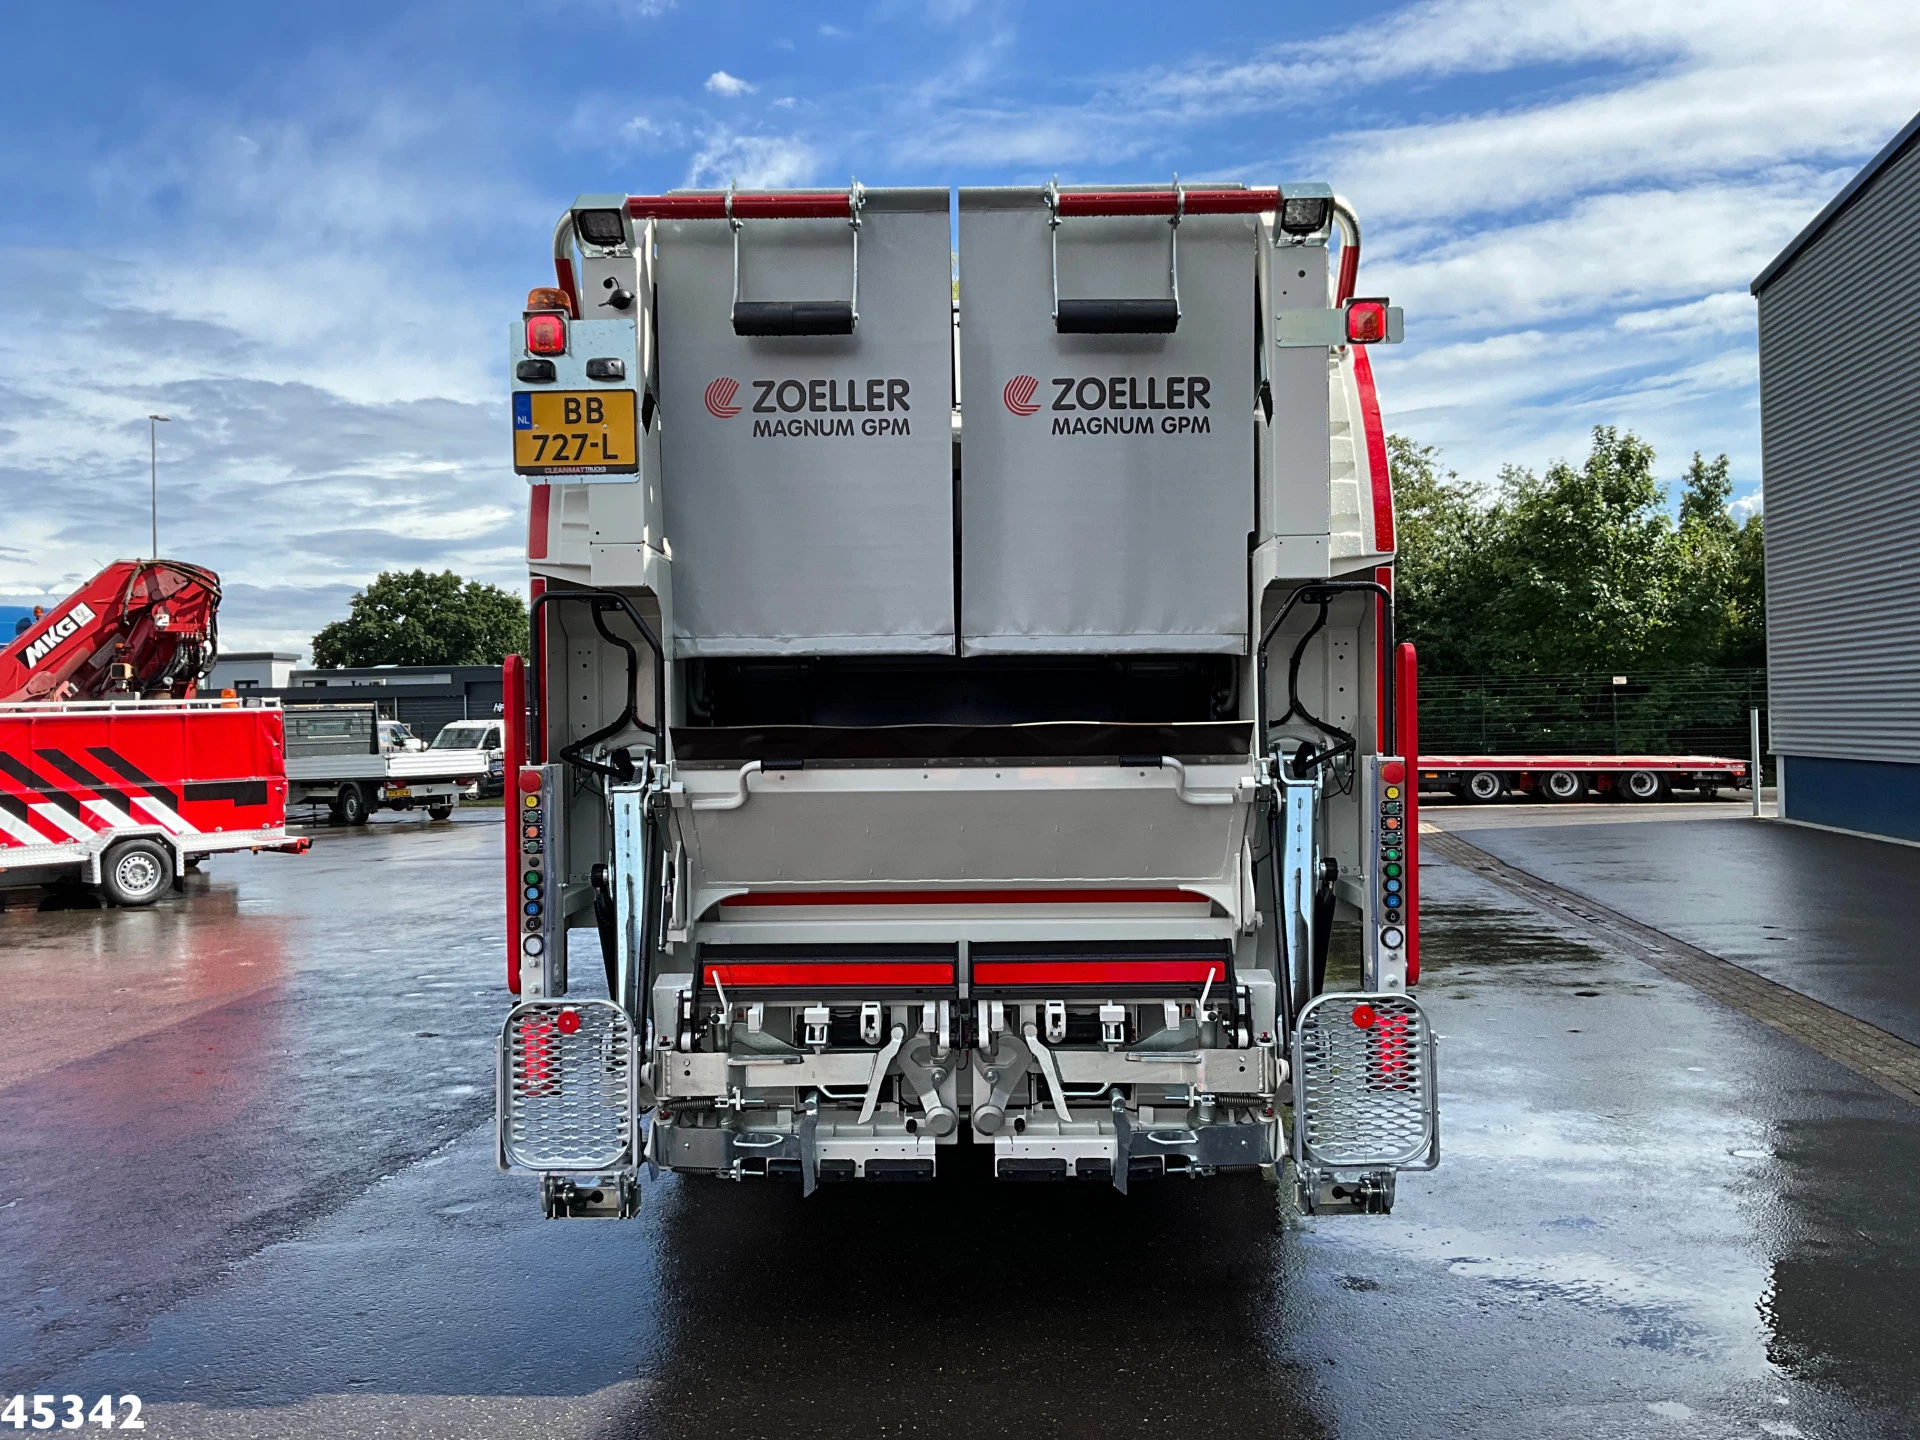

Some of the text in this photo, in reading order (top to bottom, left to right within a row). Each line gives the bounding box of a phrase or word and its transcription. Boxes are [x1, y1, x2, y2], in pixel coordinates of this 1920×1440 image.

[752, 379, 910, 413] ZOELLER
[1051, 376, 1211, 411] ZOELLER
[517, 415, 530, 425] NL
[563, 397, 604, 425] BB
[1051, 415, 1211, 435] MAGNUM GPM
[752, 417, 911, 437] MAGNUM GPM
[532, 433, 618, 462] 727-L
[25, 616, 79, 669] MKG
